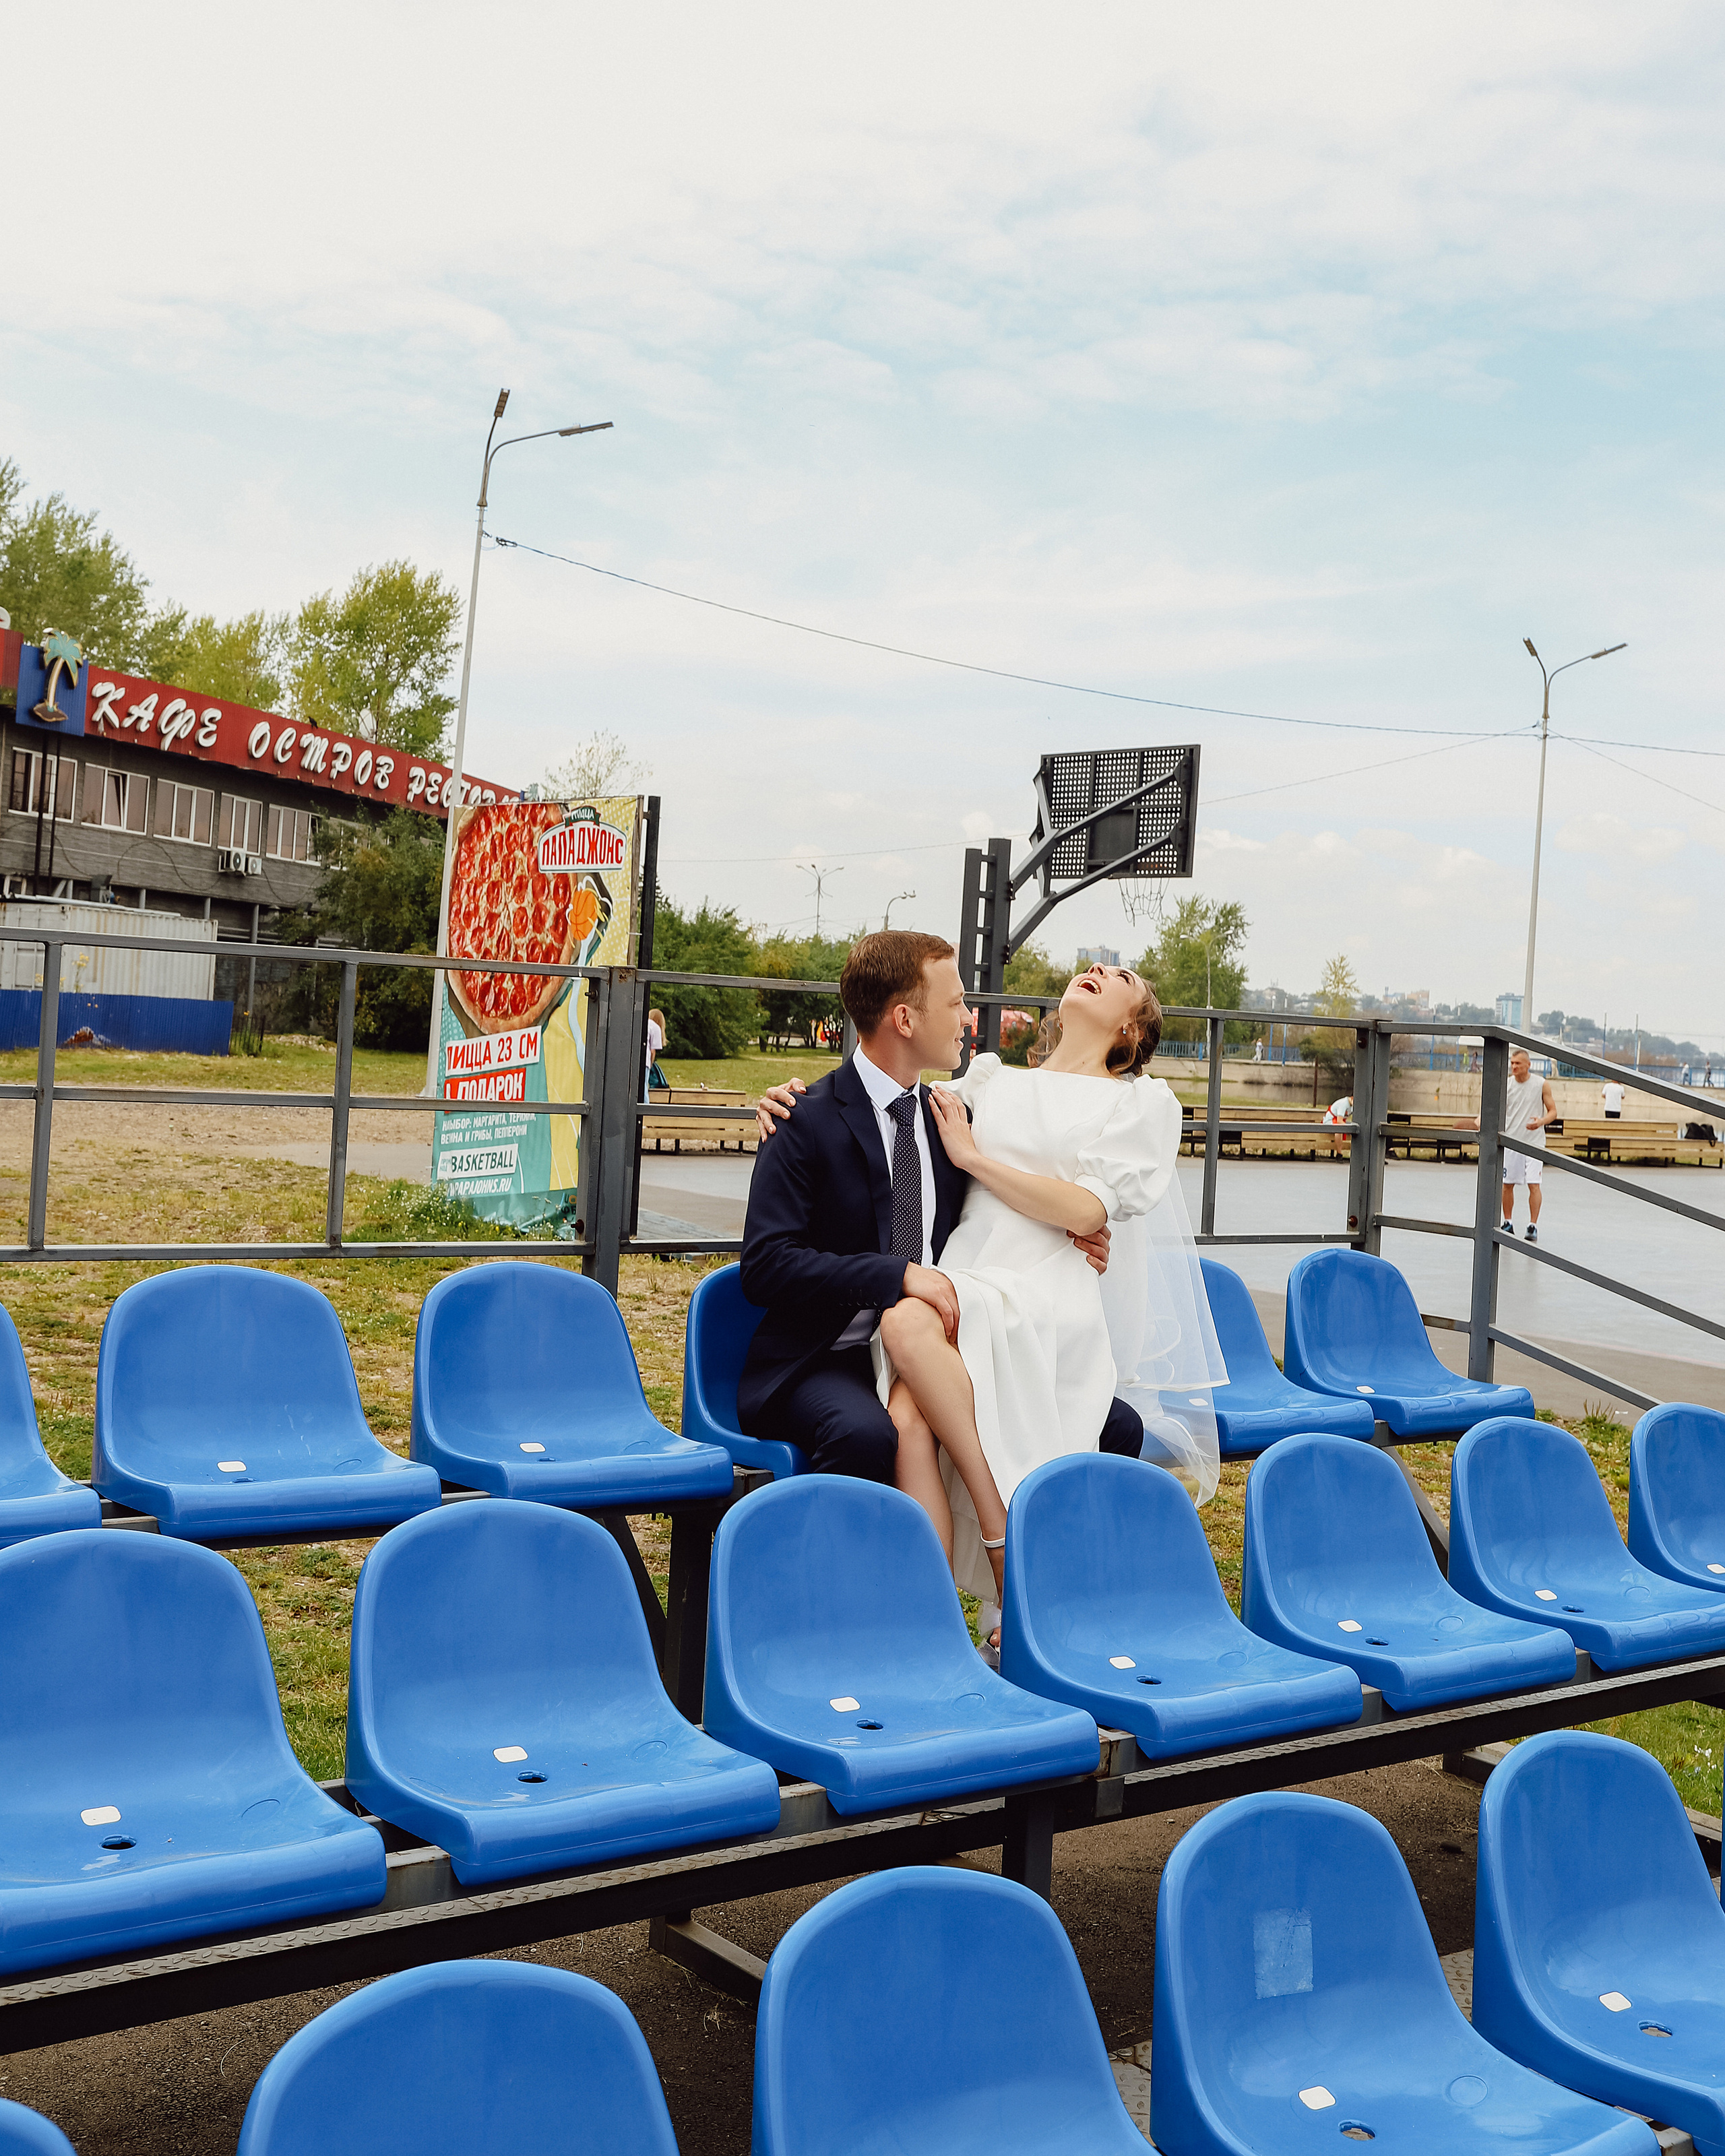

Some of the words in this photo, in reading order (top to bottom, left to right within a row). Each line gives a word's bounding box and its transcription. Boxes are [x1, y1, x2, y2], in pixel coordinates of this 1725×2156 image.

[91, 681, 222, 751] КАФЕ
[247, 720, 395, 790] ОСТРОВ
[497, 1036, 513, 1063] 23
[519, 1031, 538, 1059] СМ
[472, 1112, 507, 1129] МАРГАРИТА,
[464, 1131, 470, 1143] И
[470, 1129, 493, 1142] ГРИБЫ,
[494, 1124, 528, 1139] ПЕППЕРОНИ
[451, 1149, 514, 1173] BASKETBALL
